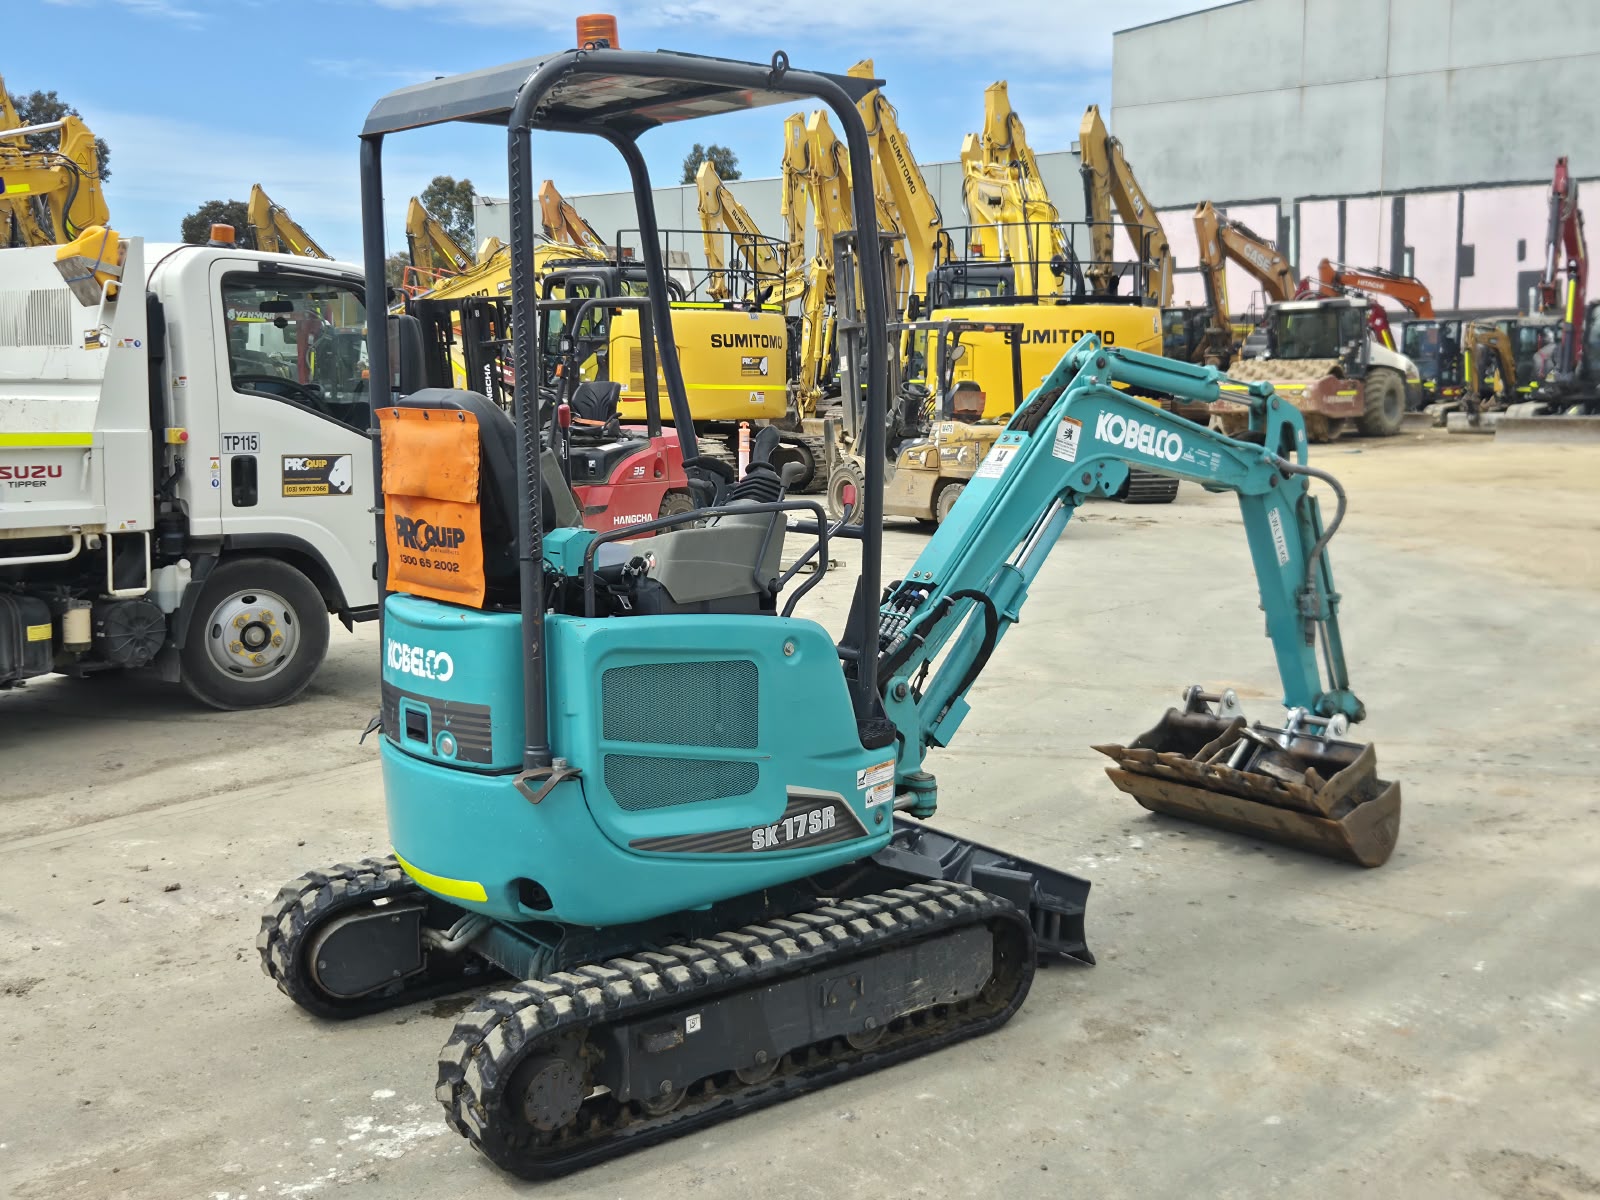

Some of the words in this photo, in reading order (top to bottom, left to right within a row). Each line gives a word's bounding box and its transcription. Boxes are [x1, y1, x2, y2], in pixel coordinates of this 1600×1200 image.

[888, 133, 917, 195] SUMITOMO
[454, 253, 467, 268] CAT
[1244, 243, 1271, 272] CASE
[711, 333, 783, 350] SUMITOMO
[223, 435, 258, 451] TP115
[1095, 410, 1183, 462] KOBELCO
[633, 466, 646, 476] 35
[7, 480, 48, 489] TIPPER
[613, 513, 654, 526] HANGCHA
[399, 554, 418, 566] 1300
[419, 557, 432, 569] 65
[433, 560, 460, 573] 2002
[387, 638, 454, 683] KOBELCO
